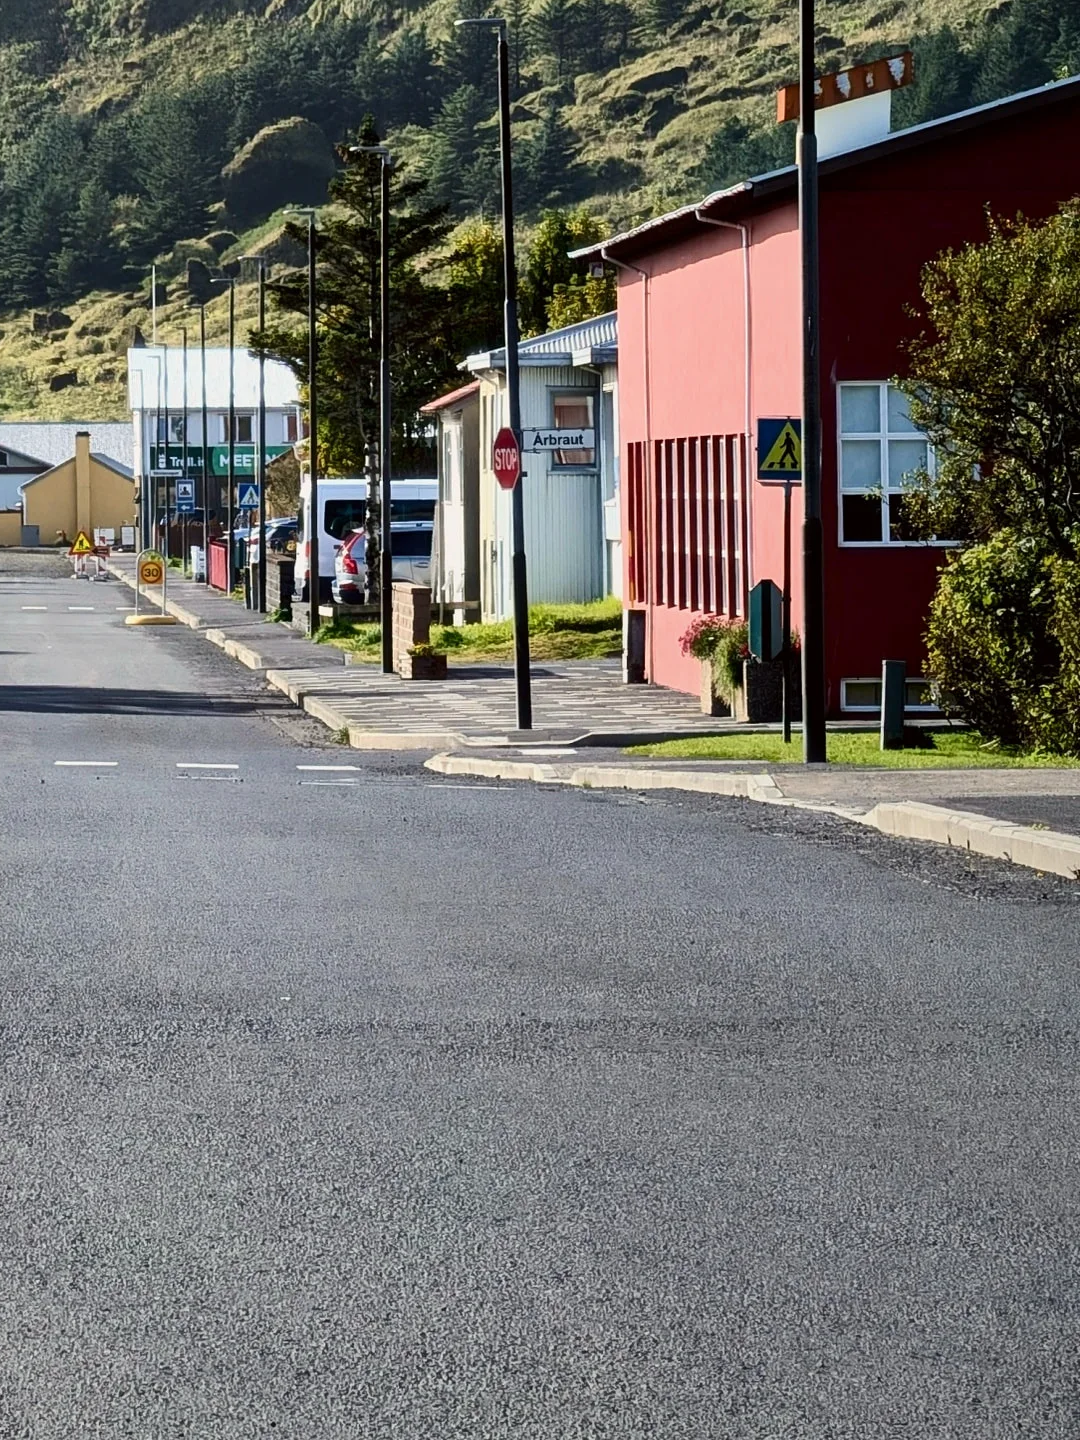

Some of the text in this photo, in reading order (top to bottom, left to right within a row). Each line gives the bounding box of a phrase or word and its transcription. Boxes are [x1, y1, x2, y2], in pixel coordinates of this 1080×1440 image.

[533, 432, 584, 446] Árbraut
[495, 447, 517, 471] STOP
[144, 568, 159, 578] 30
